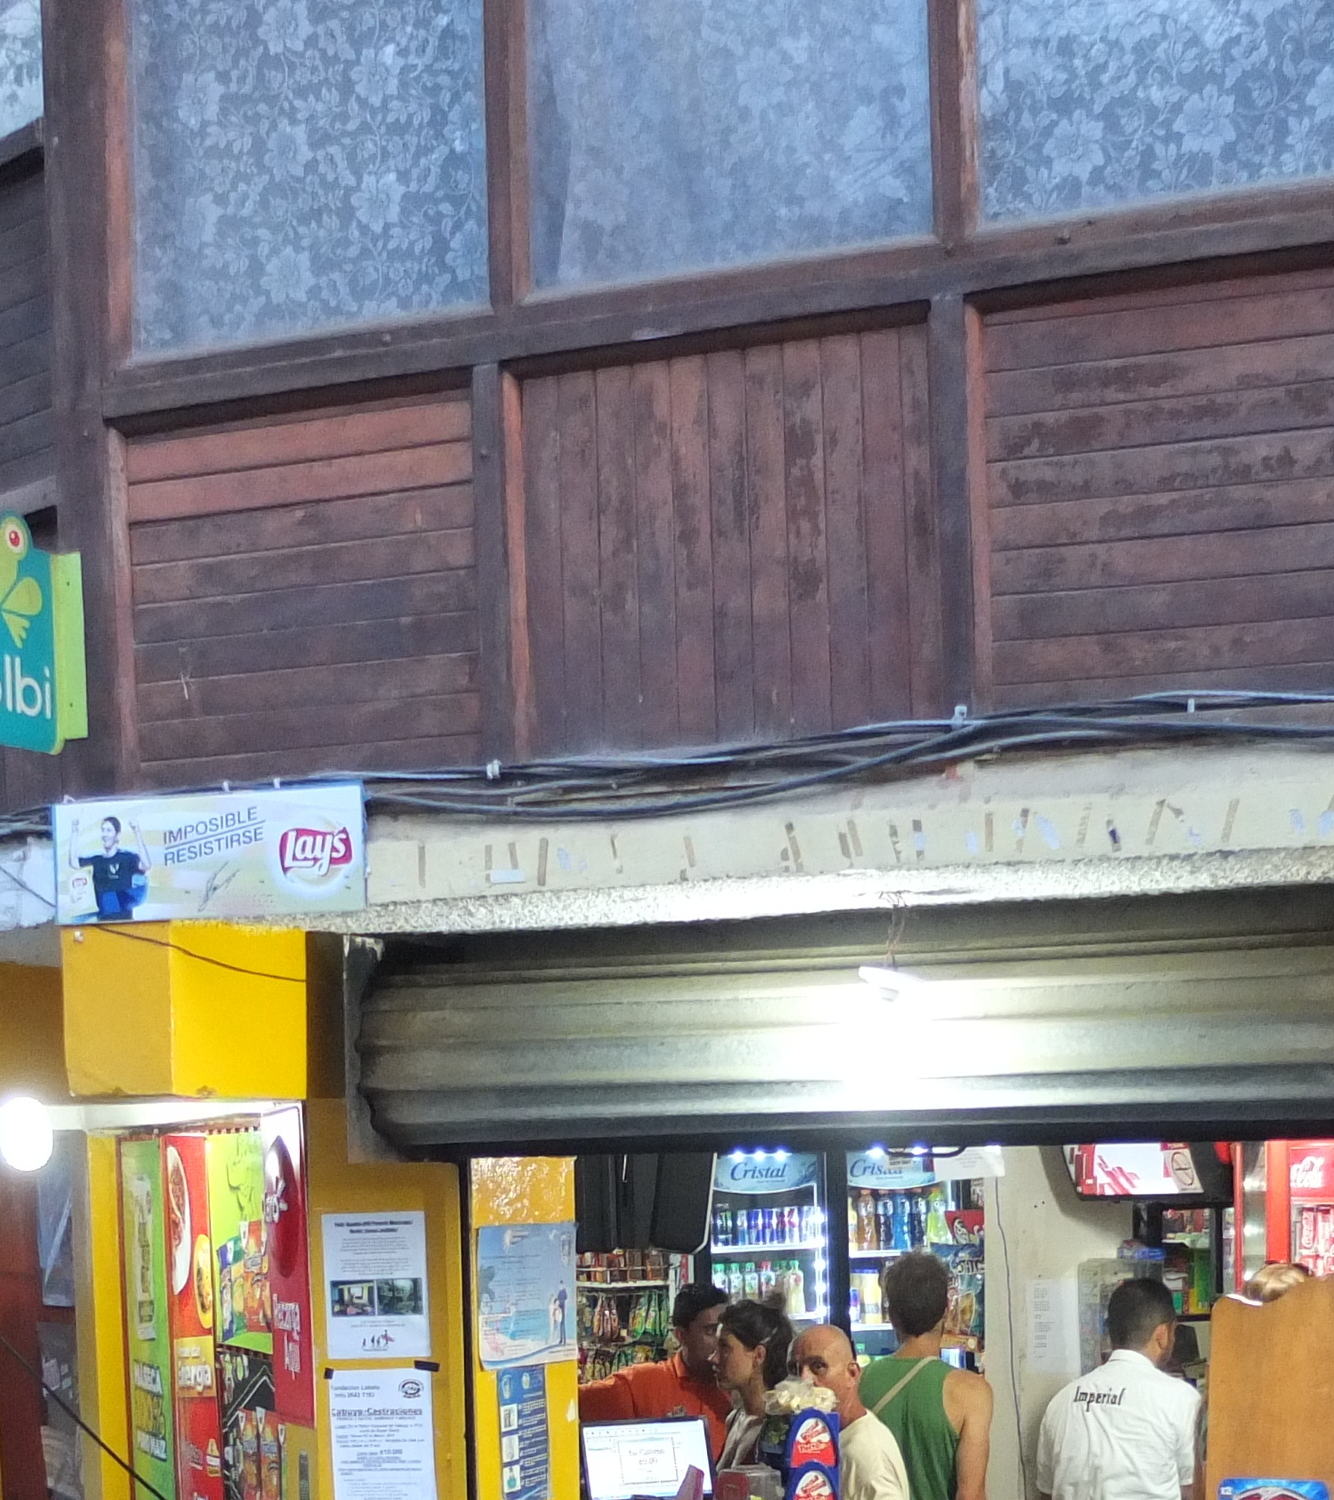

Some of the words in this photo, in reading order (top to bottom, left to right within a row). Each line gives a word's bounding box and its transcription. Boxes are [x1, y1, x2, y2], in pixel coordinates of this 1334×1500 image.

[163, 806, 258, 845] IMPOSIBLE
[164, 826, 265, 867] RESISTIRSE
[284, 826, 349, 875] Lay's
[730, 1160, 787, 1181] Cristal
[1073, 1386, 1126, 1412] Imperial
